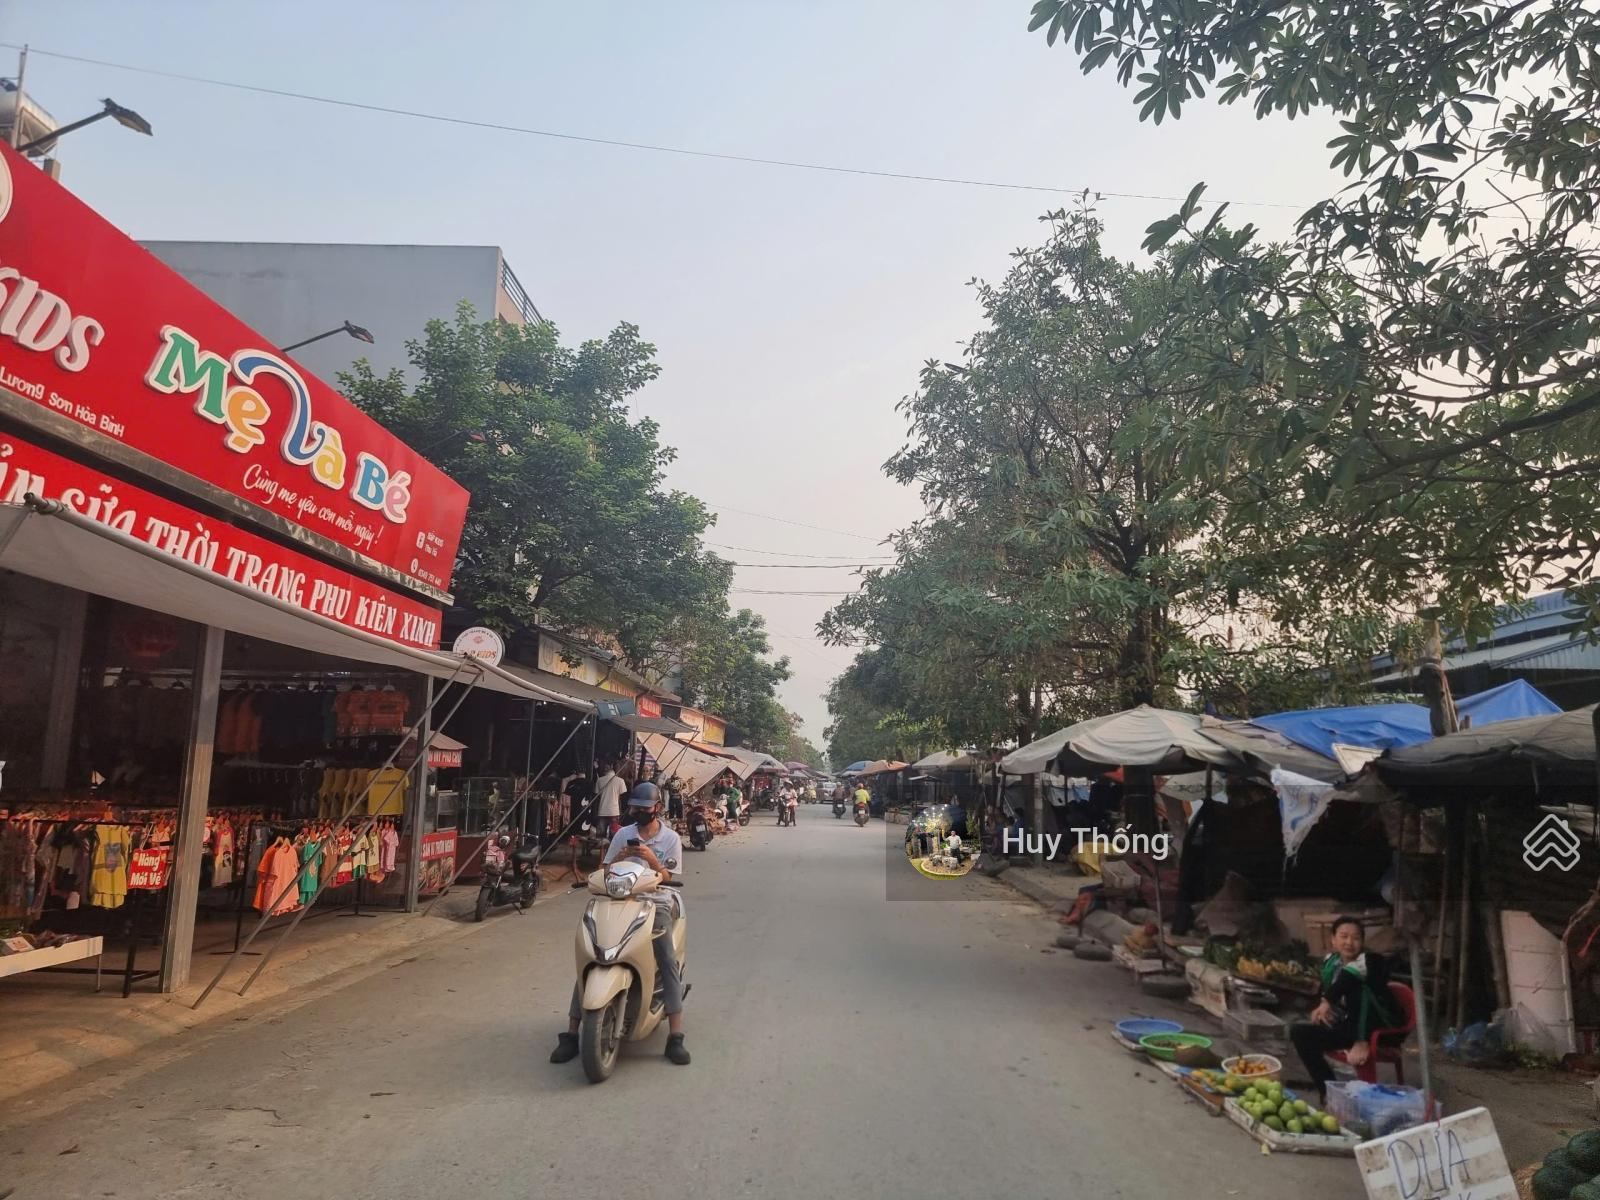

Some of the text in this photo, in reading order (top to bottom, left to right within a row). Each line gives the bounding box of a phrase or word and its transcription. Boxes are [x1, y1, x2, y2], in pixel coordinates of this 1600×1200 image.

[144, 324, 271, 453] Mẹ
[350, 451, 411, 523] Bé
[243, 463, 279, 505] Cùng
[277, 487, 297, 509] mẹ
[145, 517, 219, 570] THỜI
[226, 547, 306, 607] TRANG
[400, 612, 436, 647] XINH
